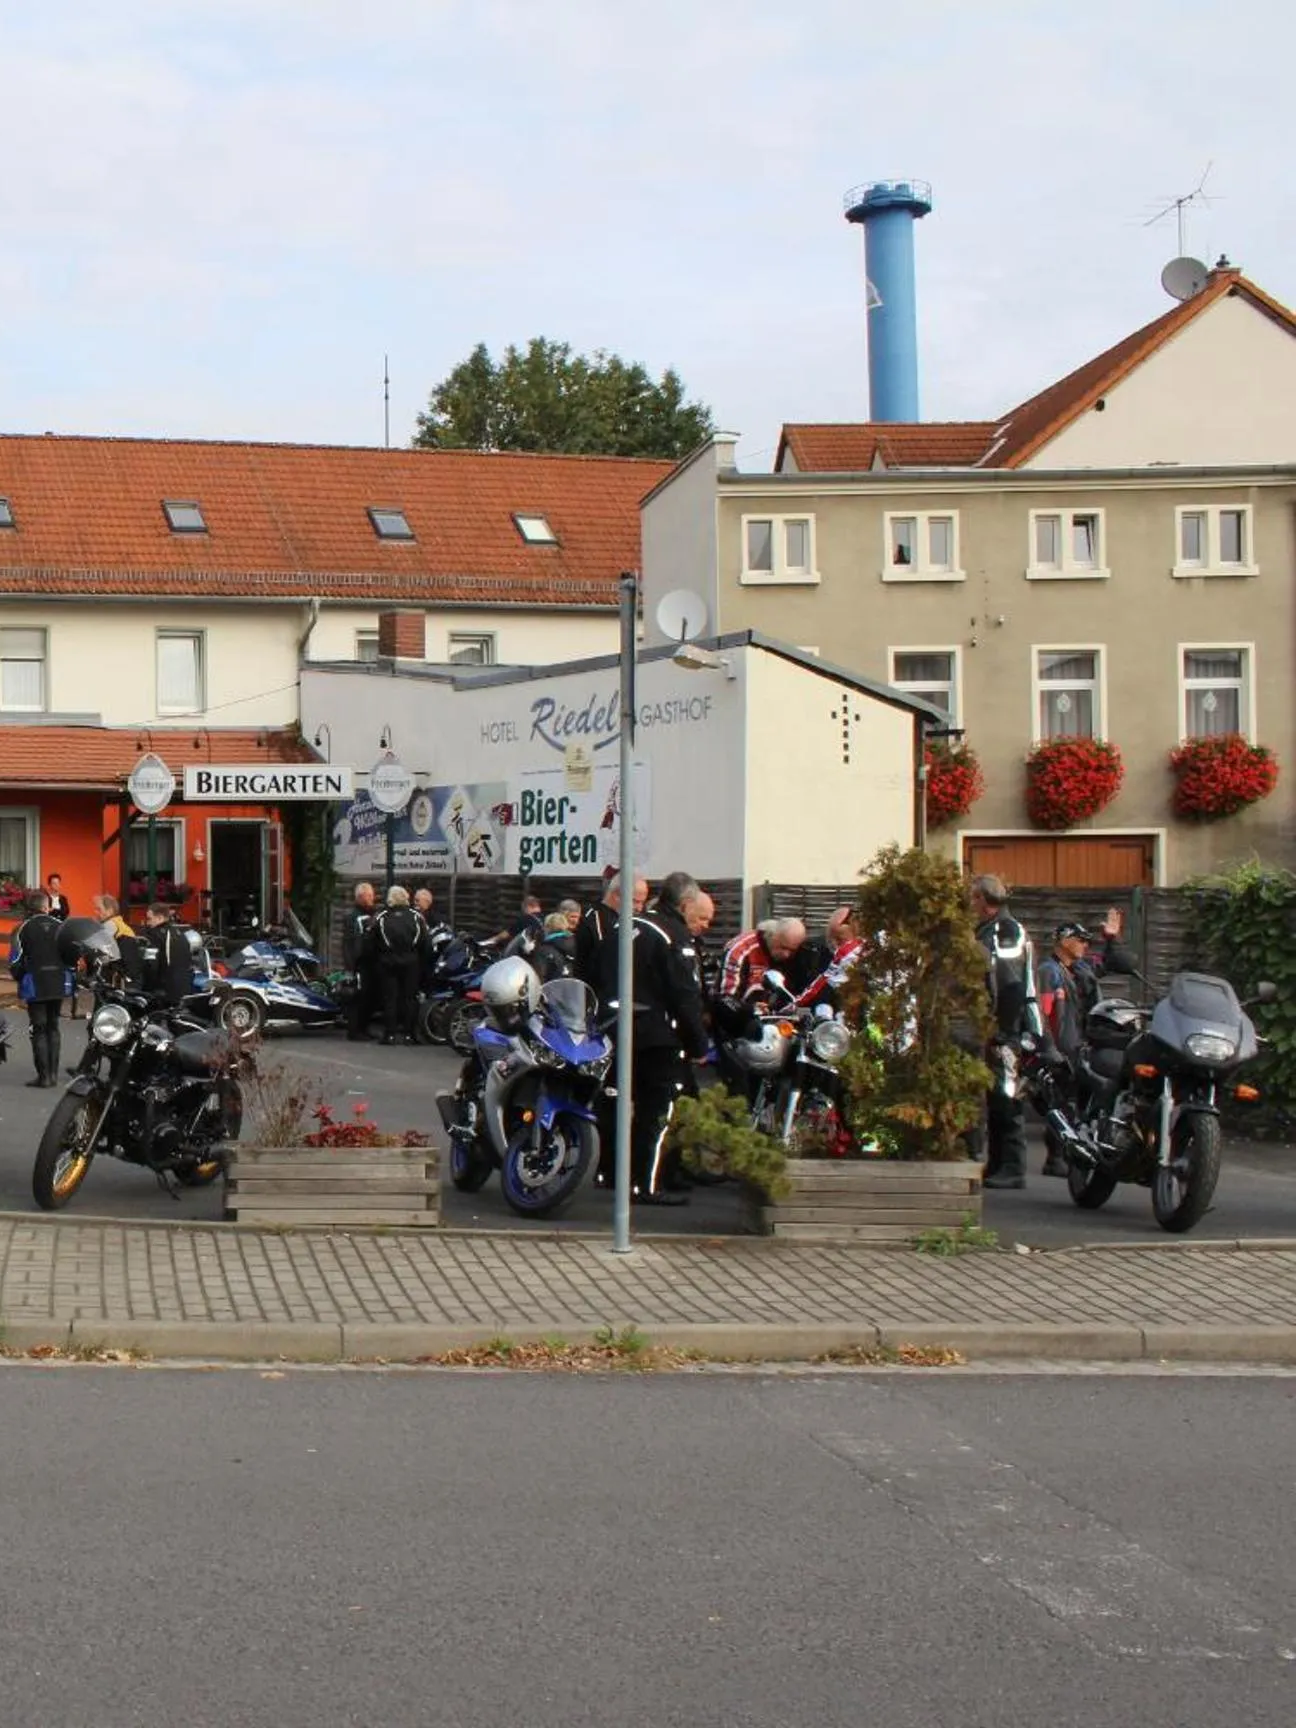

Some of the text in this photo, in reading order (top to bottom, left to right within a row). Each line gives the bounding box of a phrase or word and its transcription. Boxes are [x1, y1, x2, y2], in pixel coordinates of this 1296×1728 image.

[480, 689, 713, 744] HOTEL Riedel GASTHOF
[196, 770, 342, 794] BIERGARTEN
[521, 790, 577, 827] Bier-
[519, 829, 597, 876] garten
